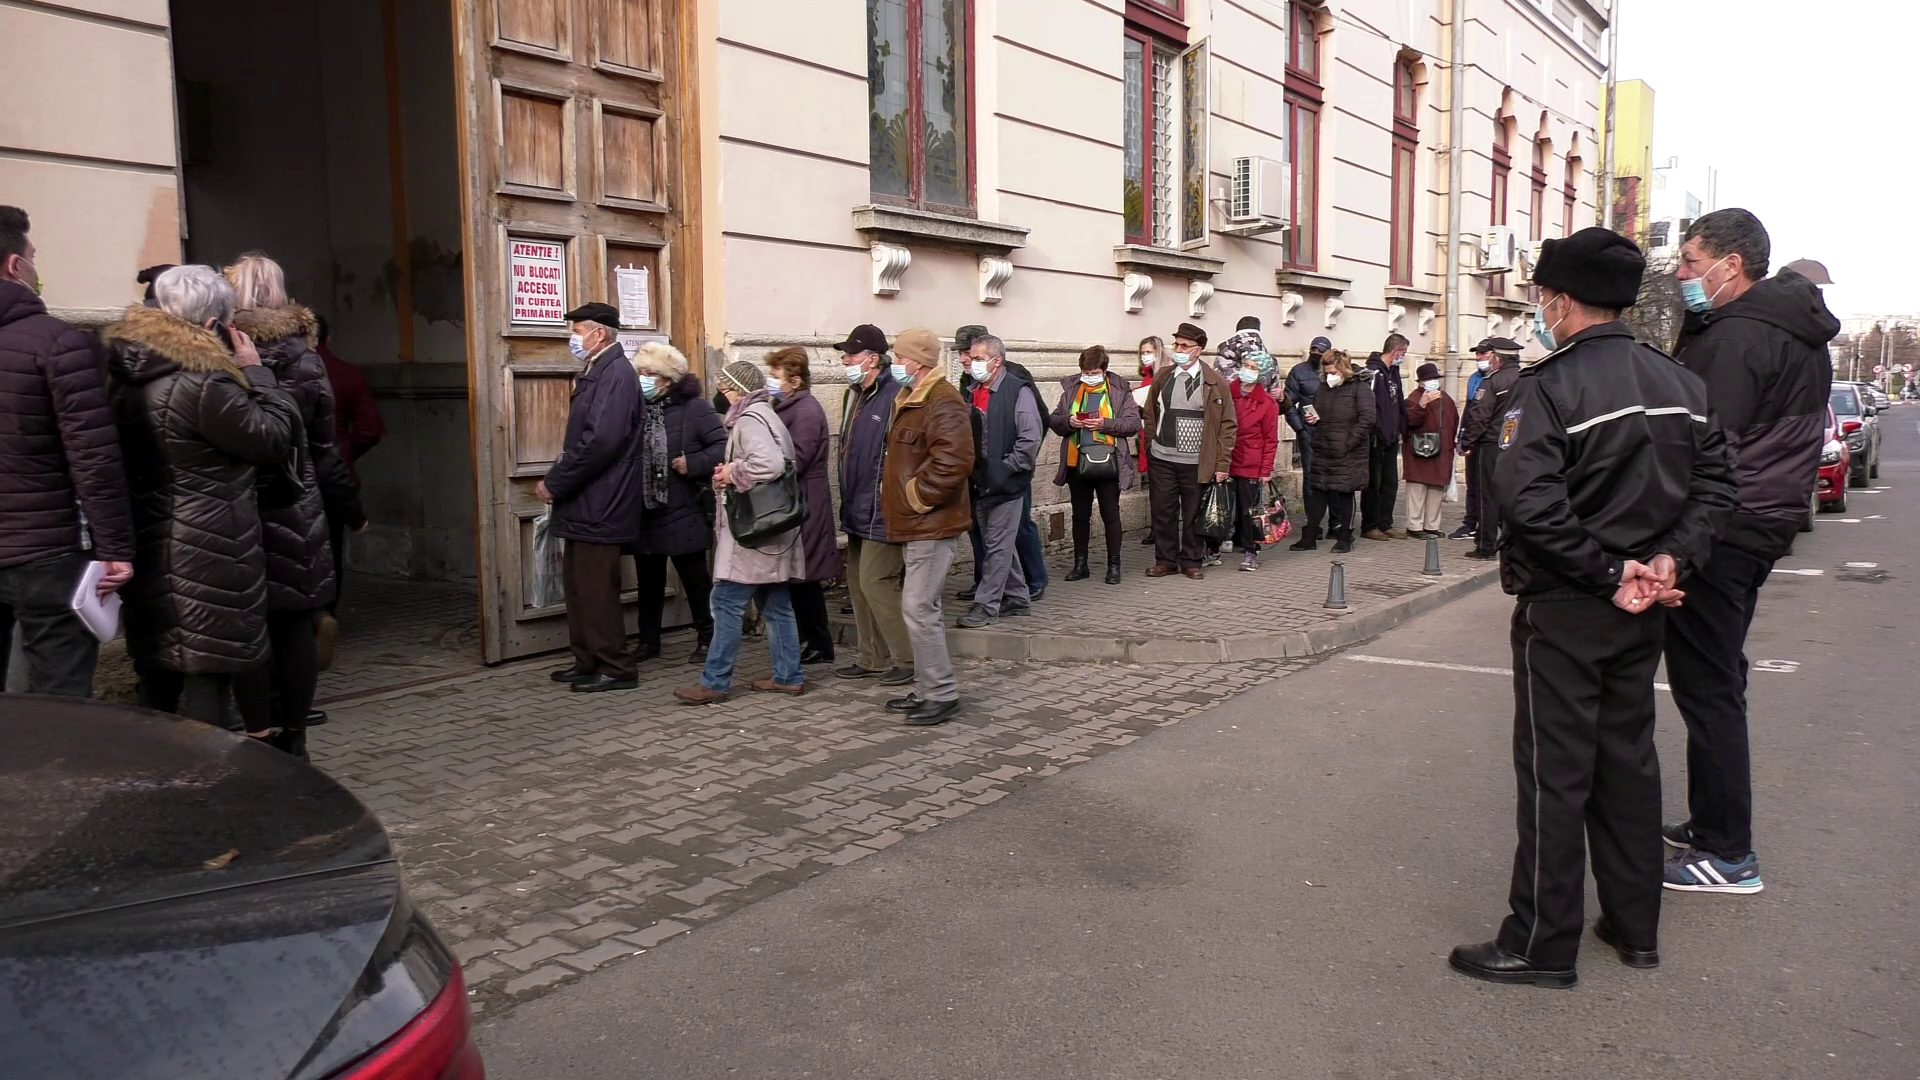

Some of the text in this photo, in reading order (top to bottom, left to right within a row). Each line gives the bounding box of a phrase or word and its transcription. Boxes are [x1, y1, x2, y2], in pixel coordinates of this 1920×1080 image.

[513, 264, 525, 277] NU
[517, 281, 559, 295] ACCESUL
[528, 297, 562, 307] CURTEA
